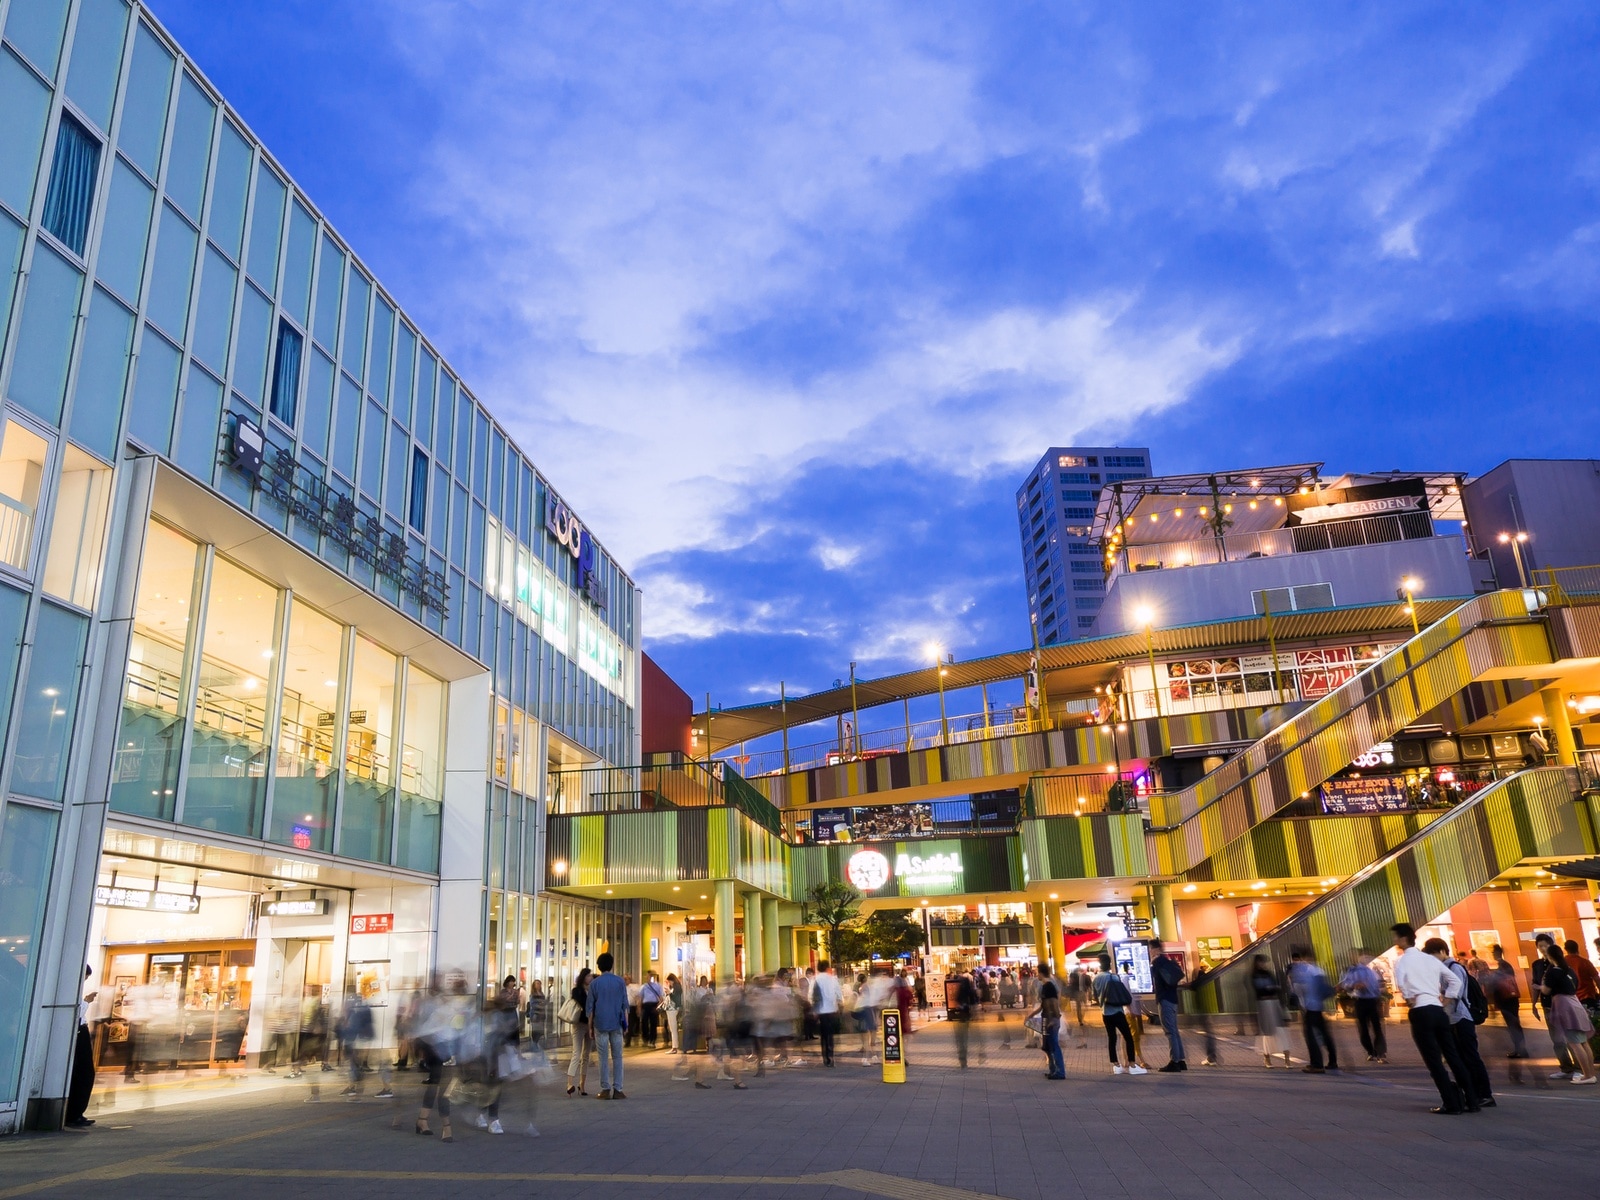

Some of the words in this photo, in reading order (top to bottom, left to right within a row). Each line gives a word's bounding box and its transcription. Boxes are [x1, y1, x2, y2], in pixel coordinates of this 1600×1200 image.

[1312, 504, 1347, 519] BEER
[1350, 498, 1406, 513] GARDEN
[1334, 779, 1363, 789] HAPPY
[1365, 778, 1390, 787] HOUR
